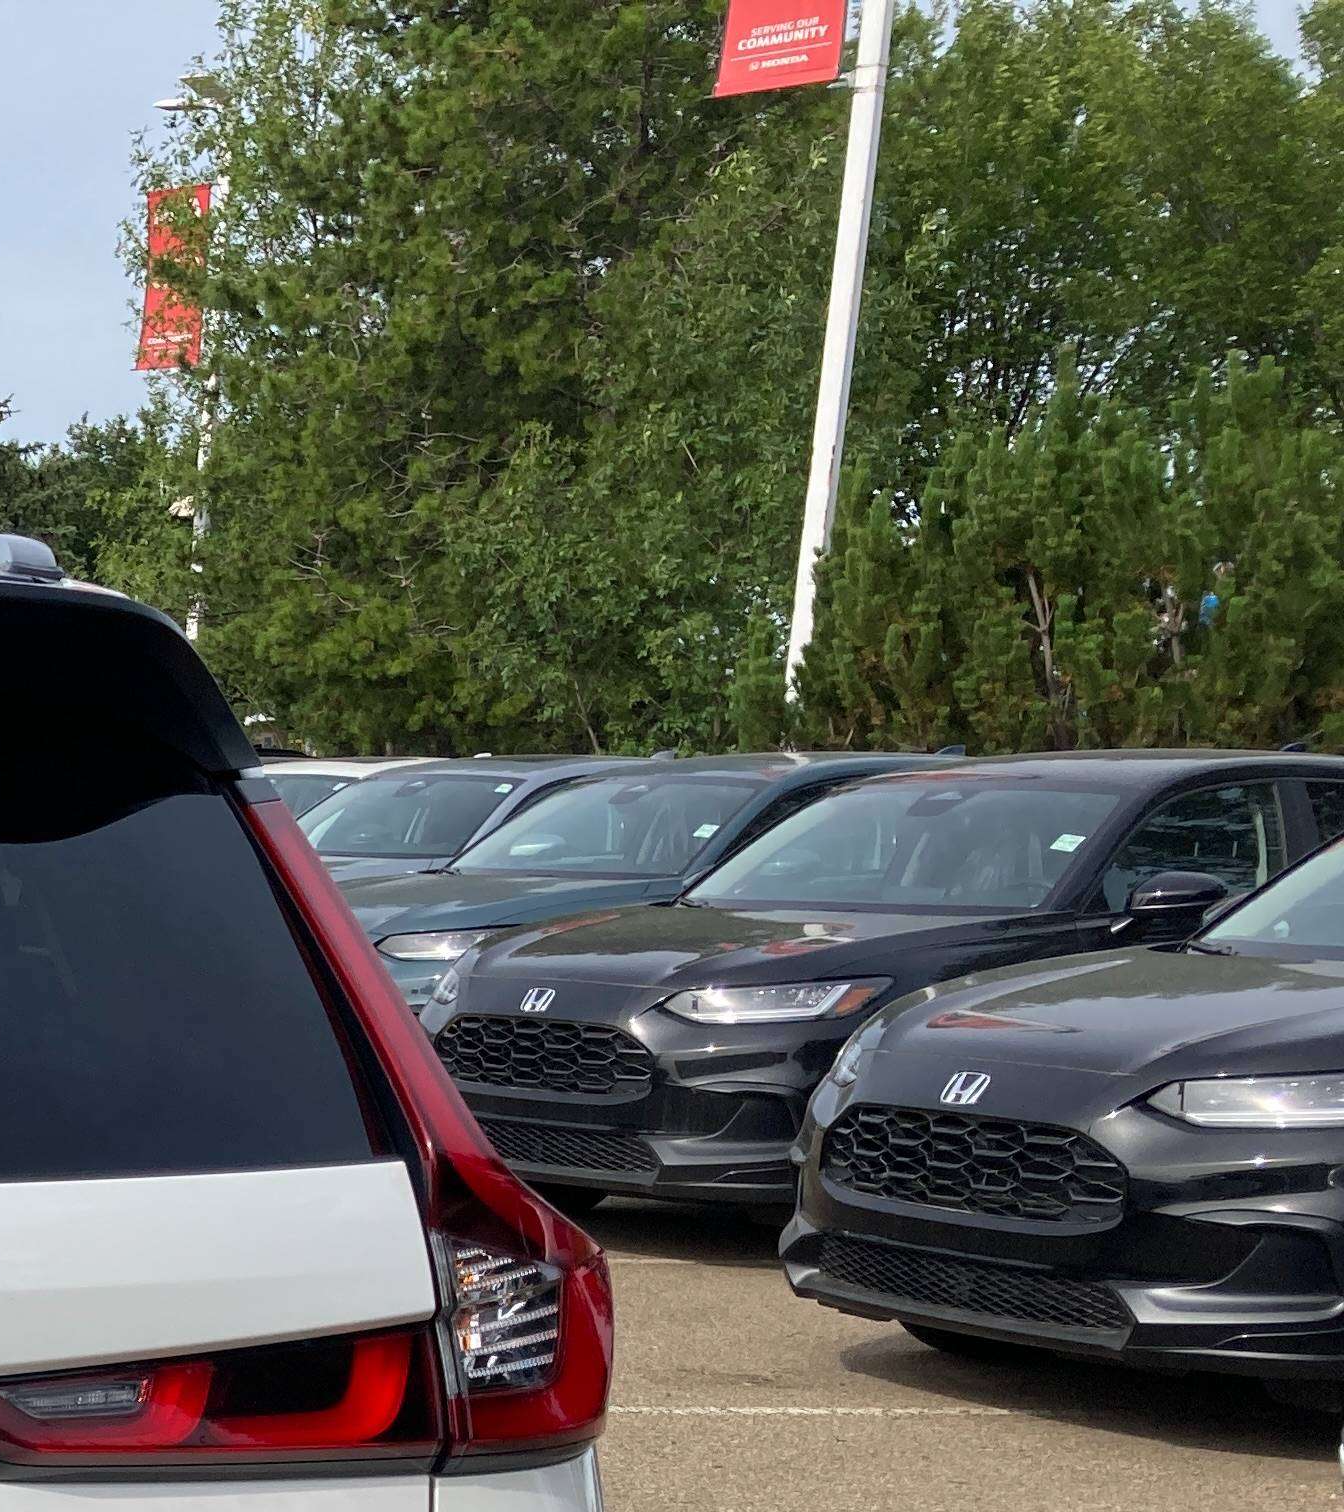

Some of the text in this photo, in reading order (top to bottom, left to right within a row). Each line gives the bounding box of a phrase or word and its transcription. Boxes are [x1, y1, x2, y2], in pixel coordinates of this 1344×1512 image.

[751, 16, 820, 37] SERVING OUR
[737, 25, 829, 51] COMMUNITY
[760, 54, 809, 69] HONDA
